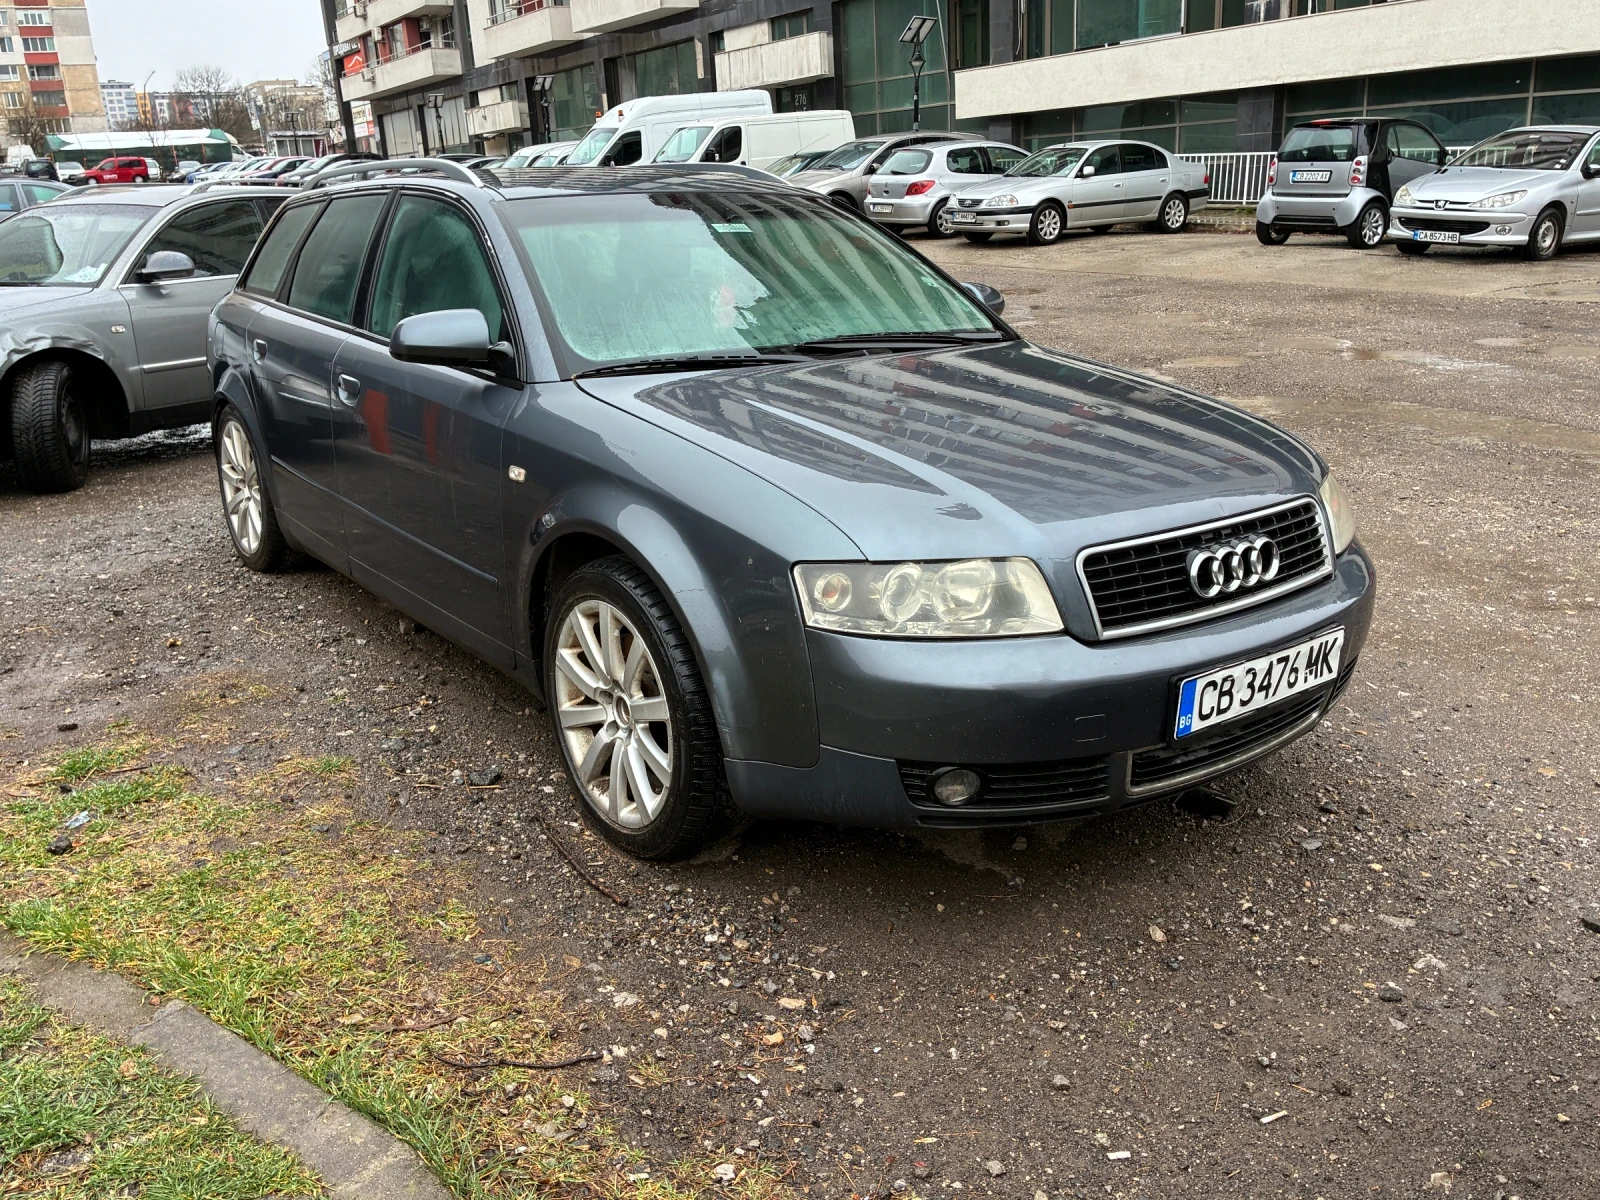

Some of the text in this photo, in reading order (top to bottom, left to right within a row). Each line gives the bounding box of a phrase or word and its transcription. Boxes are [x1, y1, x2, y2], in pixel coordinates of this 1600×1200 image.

[794, 93, 807, 106] 276
[1304, 172, 1319, 181] 2202
[1320, 172, 1329, 181] AX
[1418, 231, 1458, 242] CA 8573 HB
[1198, 637, 1338, 721] CB 3476 MK
[1179, 713, 1192, 729] BG
